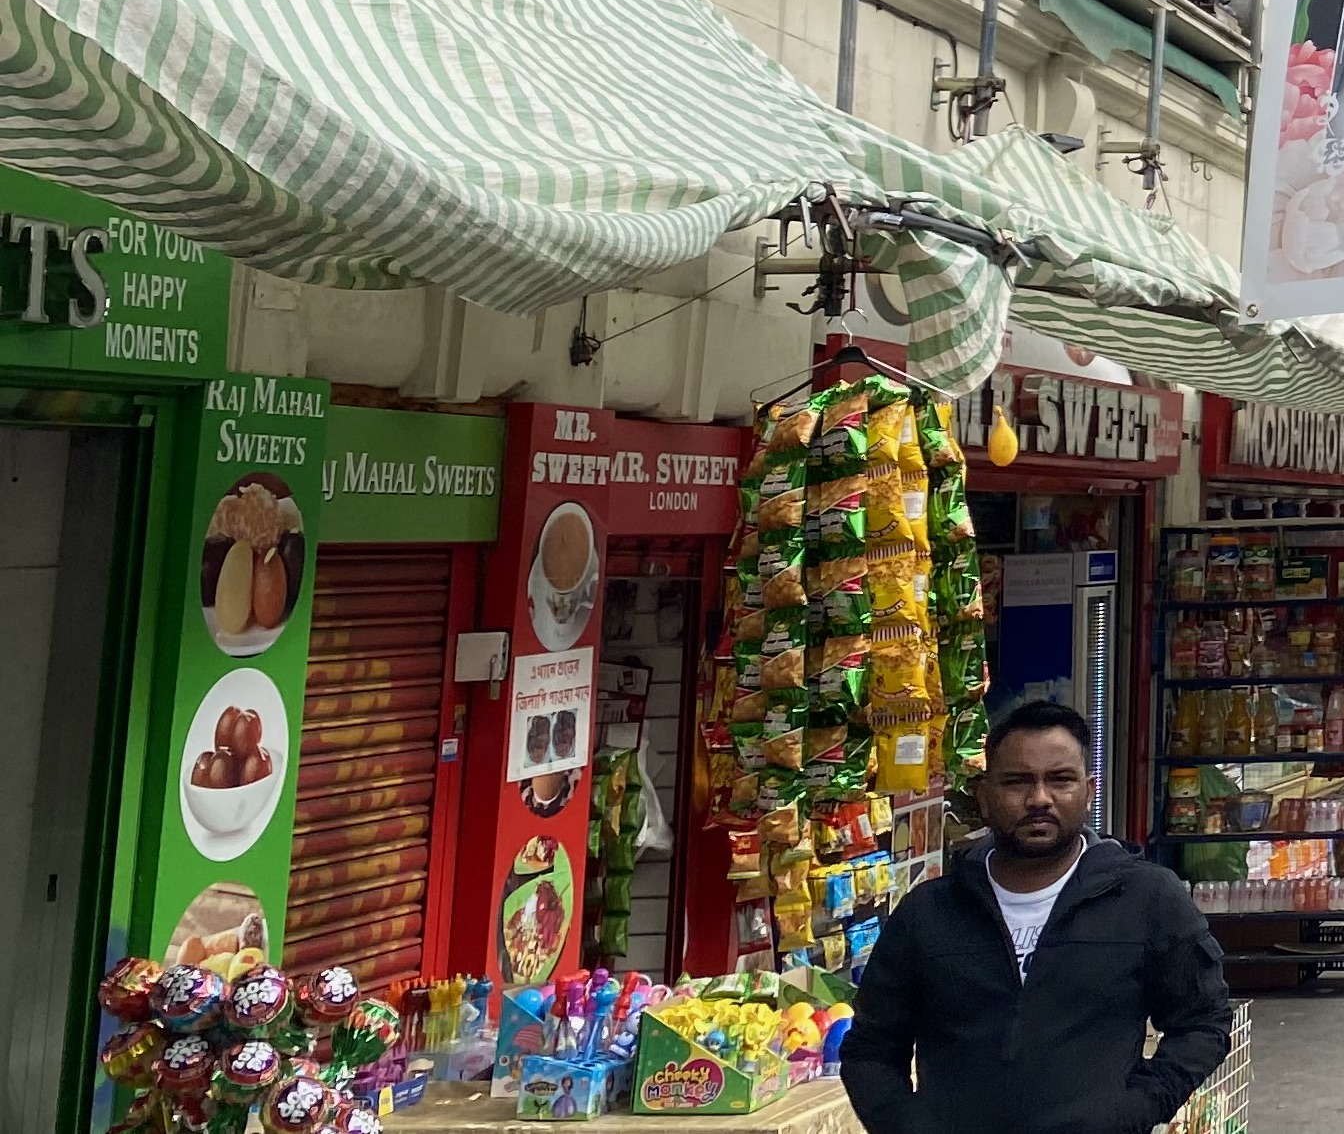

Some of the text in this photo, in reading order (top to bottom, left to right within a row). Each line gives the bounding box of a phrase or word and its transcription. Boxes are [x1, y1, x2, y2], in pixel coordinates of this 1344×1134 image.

[107, 217, 204, 264] FOR YOUR
[123, 271, 187, 311] HAPPY
[105, 322, 198, 364] MOMENTS
[554, 410, 597, 442] MR.
[1037, 375, 1161, 463] SWEET
[531, 451, 610, 485] SWEET
[656, 453, 739, 486] SWEET
[649, 491, 698, 512] LONDON
